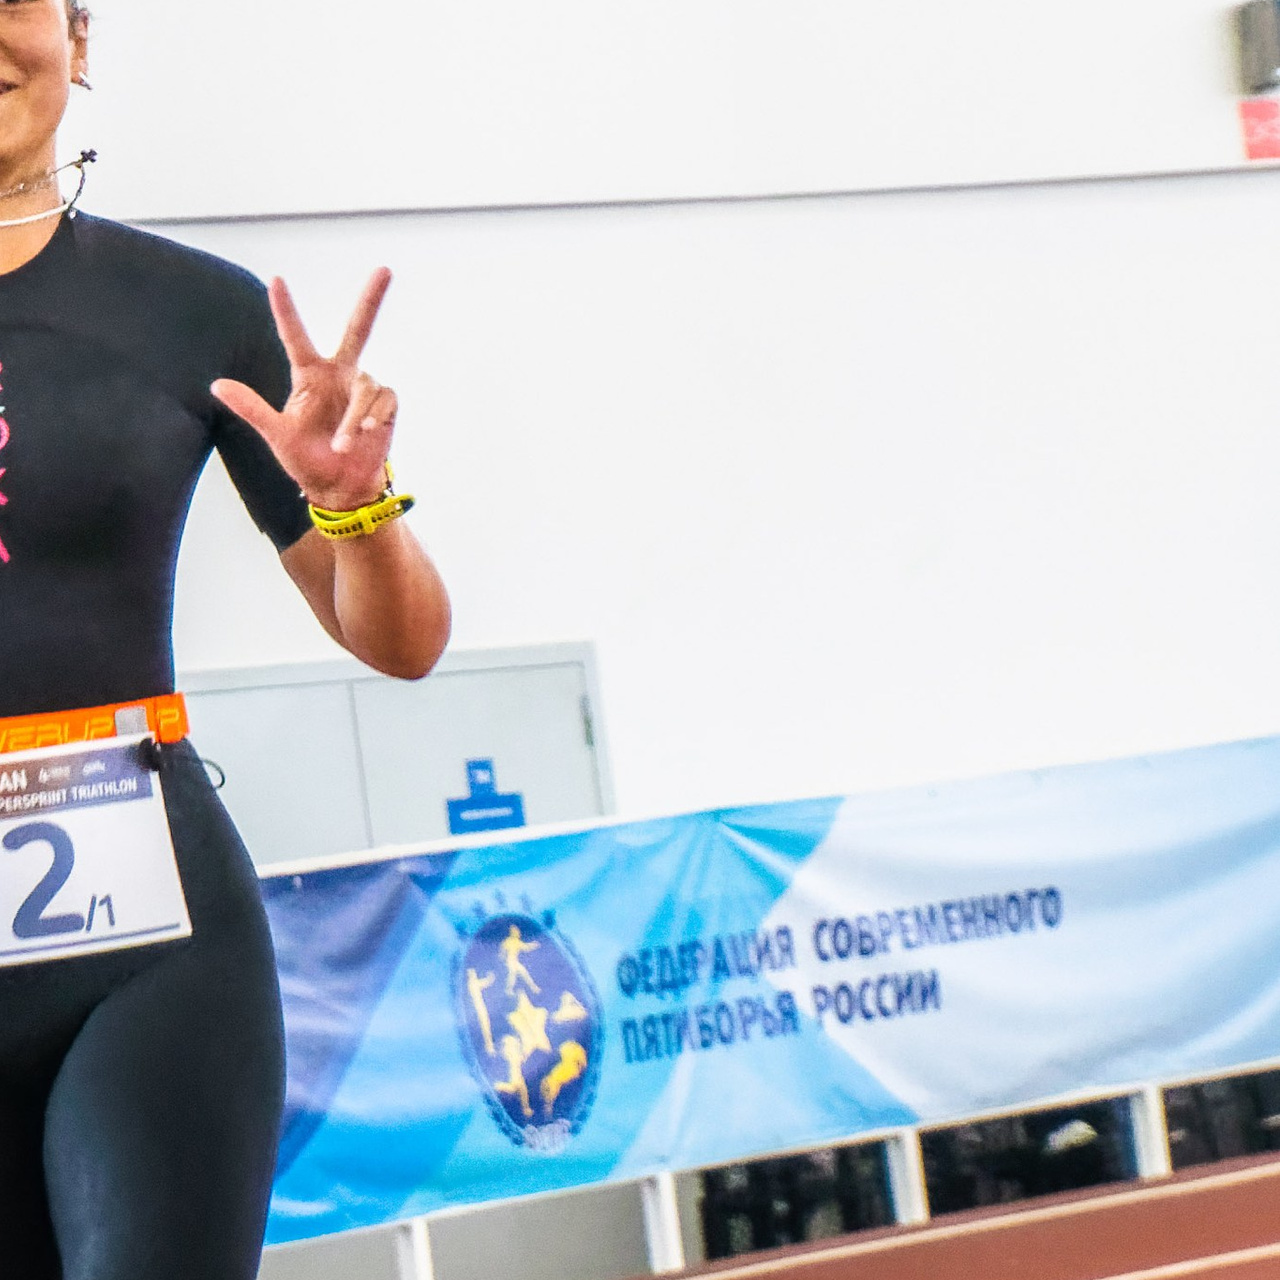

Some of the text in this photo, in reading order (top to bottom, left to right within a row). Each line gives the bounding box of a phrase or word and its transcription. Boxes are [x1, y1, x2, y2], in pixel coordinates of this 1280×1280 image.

[71, 776, 138, 801] TRIATHLON
[617, 886, 1063, 999] ФЕДЕРАЦИЯ СОВРЕМЕННОГО
[621, 968, 942, 1064] ПЯТИБОРЬЯ РОССИИ
